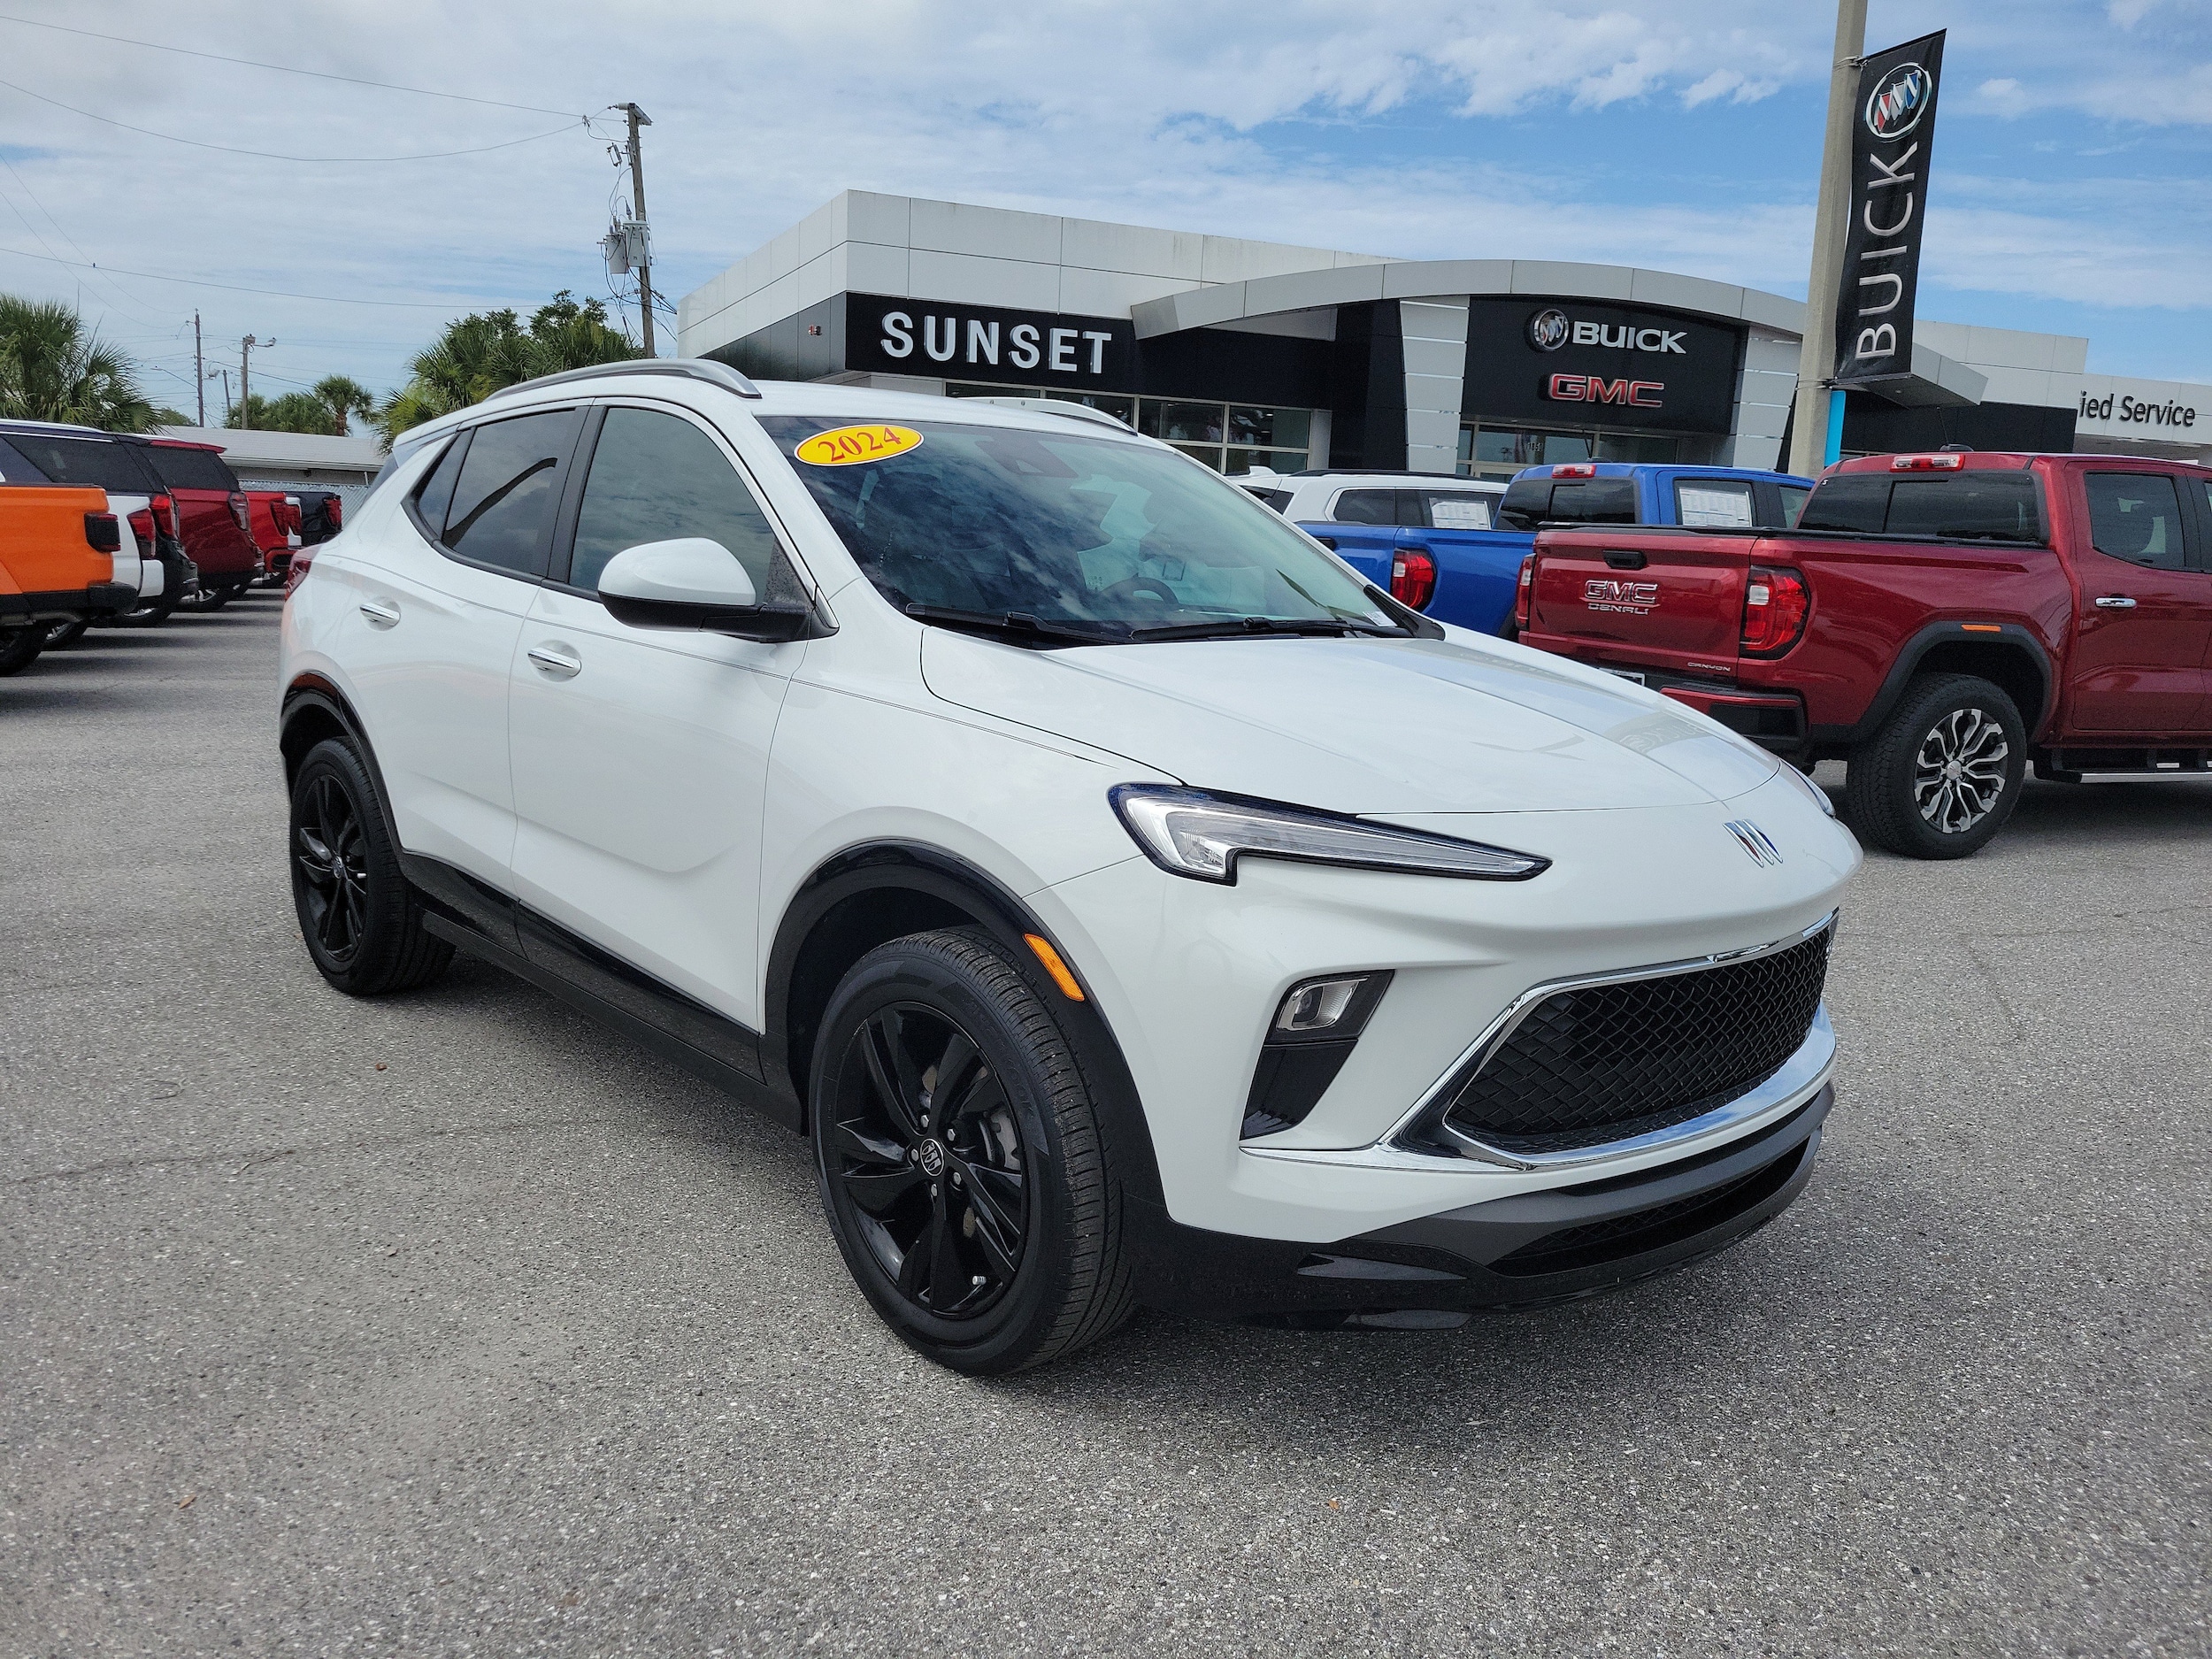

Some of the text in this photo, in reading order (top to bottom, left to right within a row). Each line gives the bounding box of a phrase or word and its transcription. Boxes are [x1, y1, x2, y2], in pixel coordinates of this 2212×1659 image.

[1855, 142, 1918, 359] BUICK
[880, 311, 1112, 374] SUNSET
[1572, 320, 1688, 355] BUICK
[1550, 373, 1665, 408] GMC
[2118, 396, 2196, 427] Service
[818, 426, 902, 463] 2024
[1584, 580, 1658, 604] GMC
[1587, 603, 1649, 616] DENALI
[1687, 661, 1732, 672] CANYON
